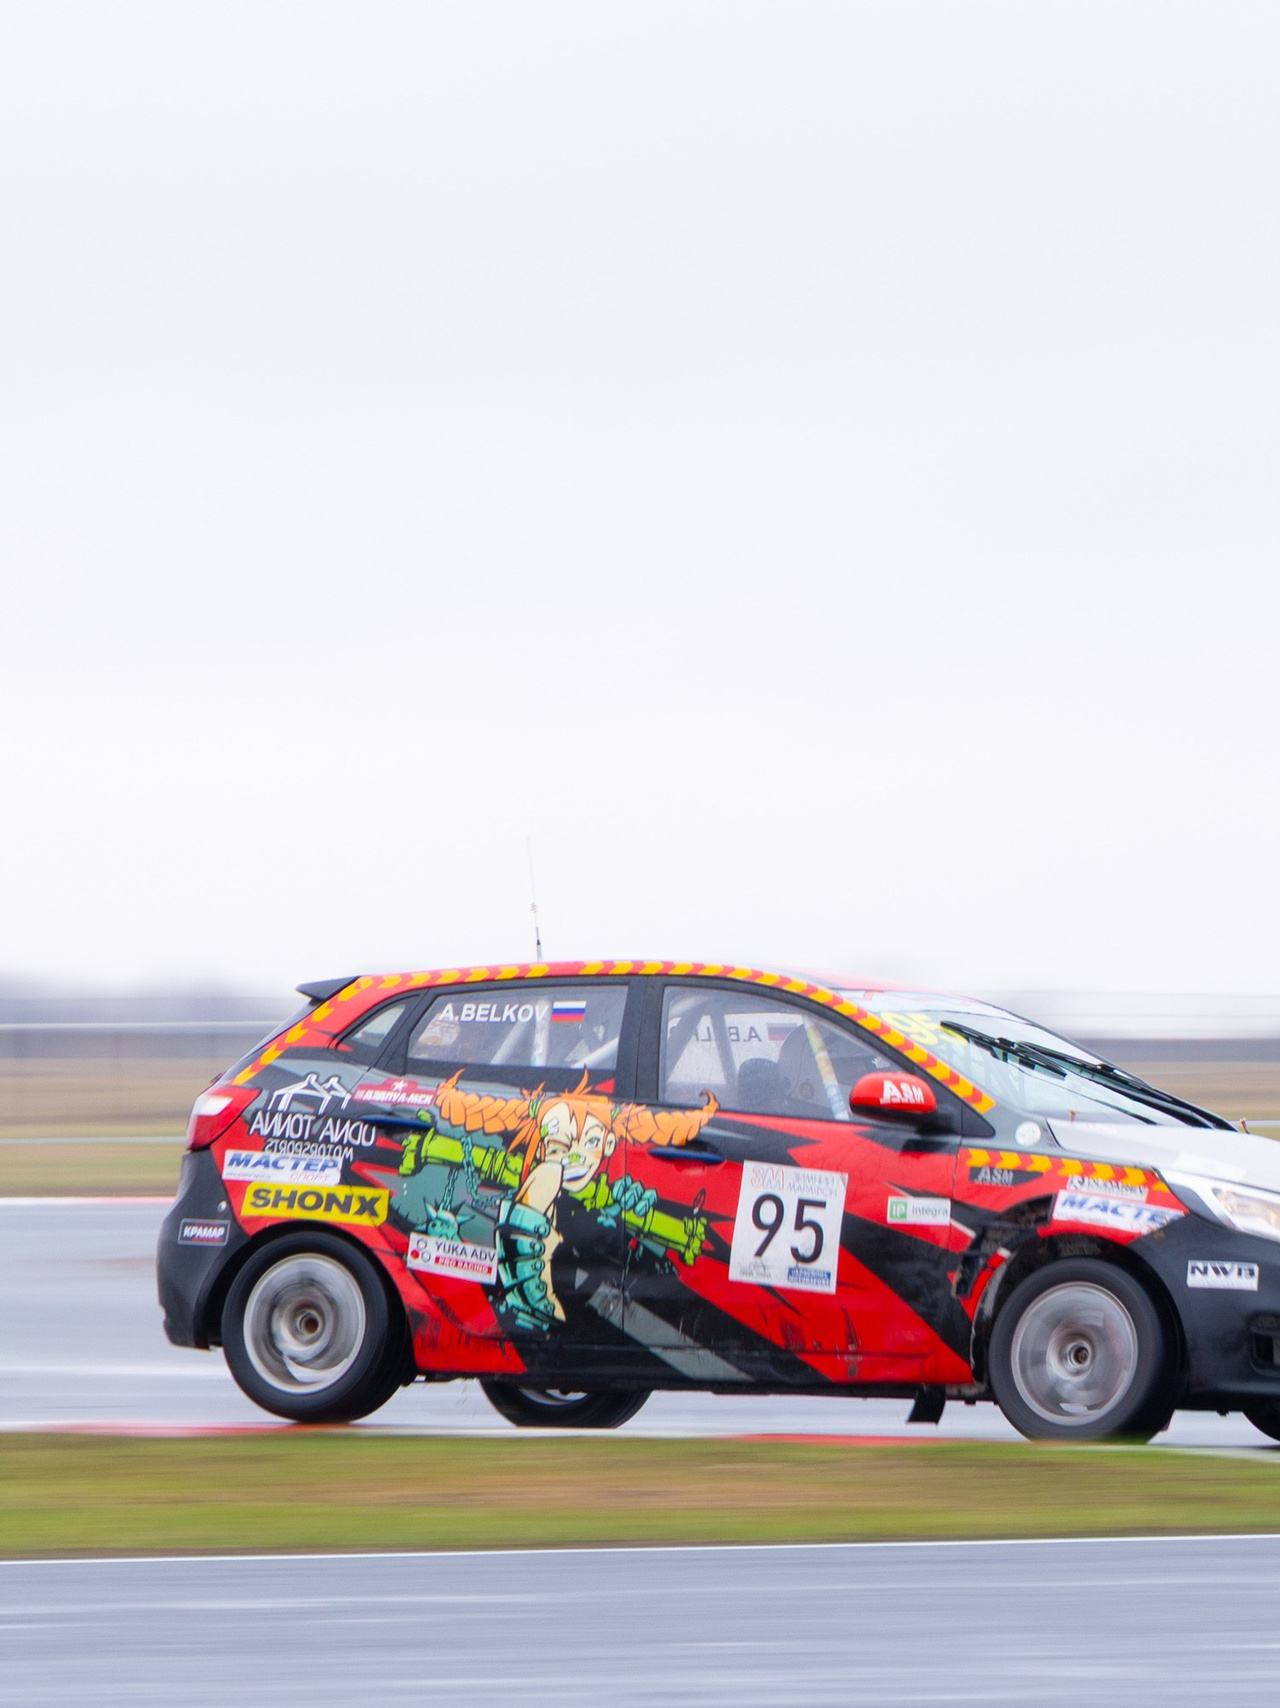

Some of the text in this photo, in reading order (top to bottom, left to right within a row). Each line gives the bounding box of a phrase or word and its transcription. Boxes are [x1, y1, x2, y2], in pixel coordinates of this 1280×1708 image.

[439, 1003, 549, 1023] A.BELKOV
[228, 1153, 339, 1173] МАСТЕР
[250, 1188, 381, 1217] SHONX
[751, 1192, 827, 1264] 95
[435, 1241, 496, 1262] YUKA ADV
